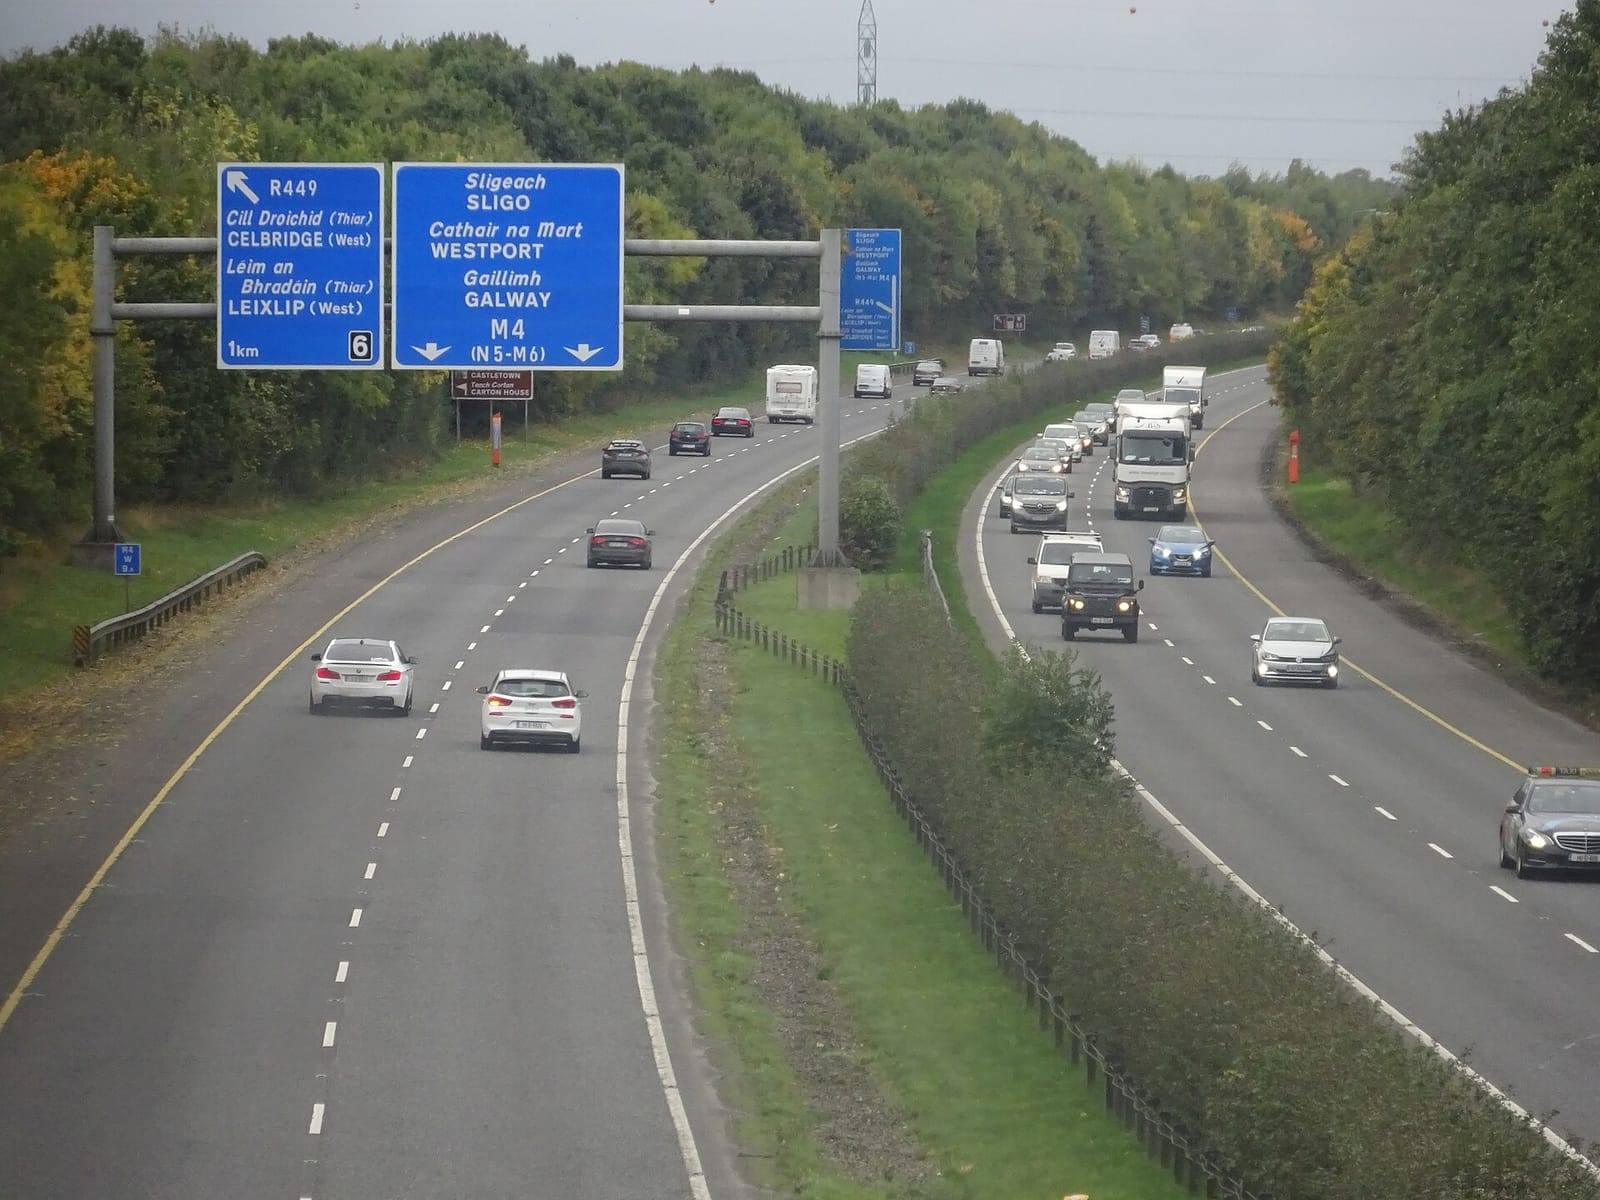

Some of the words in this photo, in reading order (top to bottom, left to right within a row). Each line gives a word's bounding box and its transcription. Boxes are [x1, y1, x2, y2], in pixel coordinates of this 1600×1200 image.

[270, 179, 317, 196] R449
[465, 173, 546, 191] Sligeach
[466, 194, 530, 210] SLIGO
[226, 210, 252, 226] Cill
[258, 210, 323, 226] Droichid
[329, 211, 373, 226] (Thiar)
[429, 221, 500, 238] Cathair
[506, 226, 529, 238] na
[537, 221, 583, 238] Mart
[228, 231, 323, 247] CELBRIDGE
[328, 233, 371, 247] (West)
[431, 242, 544, 259] WESTPORT
[226, 258, 266, 274] Léim
[273, 263, 294, 274] an
[464, 270, 541, 286] Gaillimh
[241, 279, 317, 294] Bhradáin
[325, 280, 373, 295] (Thiar)
[228, 300, 305, 315] LEIXLIP
[309, 301, 363, 316] (West)
[465, 292, 551, 308] GALWAY
[491, 318, 525, 340] M4
[228, 340, 259, 357] 1km
[352, 335, 368, 357] 6
